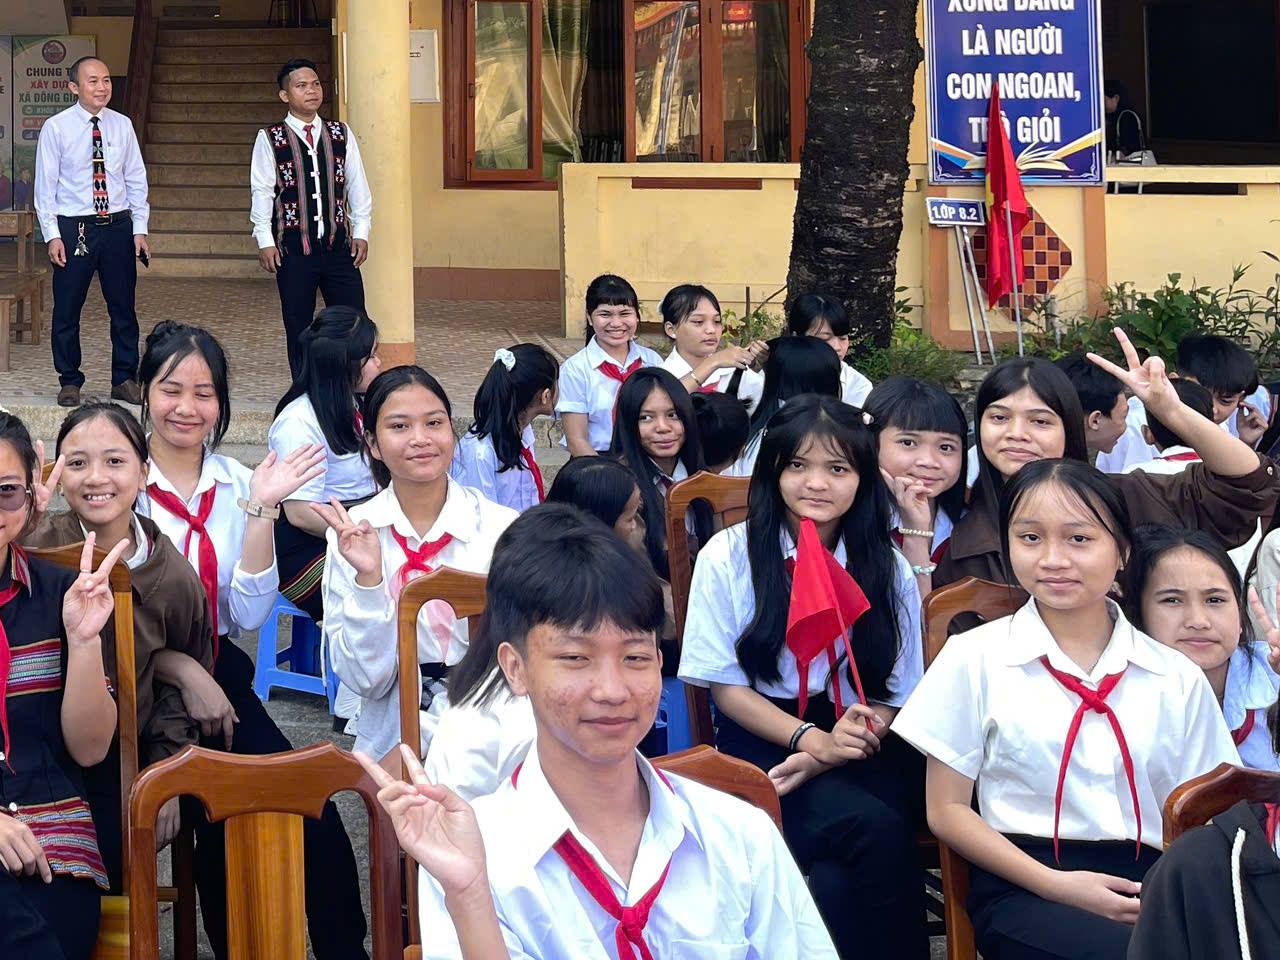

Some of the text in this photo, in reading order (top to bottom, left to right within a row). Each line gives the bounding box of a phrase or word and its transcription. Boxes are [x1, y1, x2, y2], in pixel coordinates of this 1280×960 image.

[961, 22, 1063, 55] LÀ NGƯỜI
[26, 67, 62, 77] CHUNG
[947, 72, 1081, 102] CON NGOAN,
[1016, 108, 1062, 143] GIỎI
[958, 207, 978, 221] 8.2
